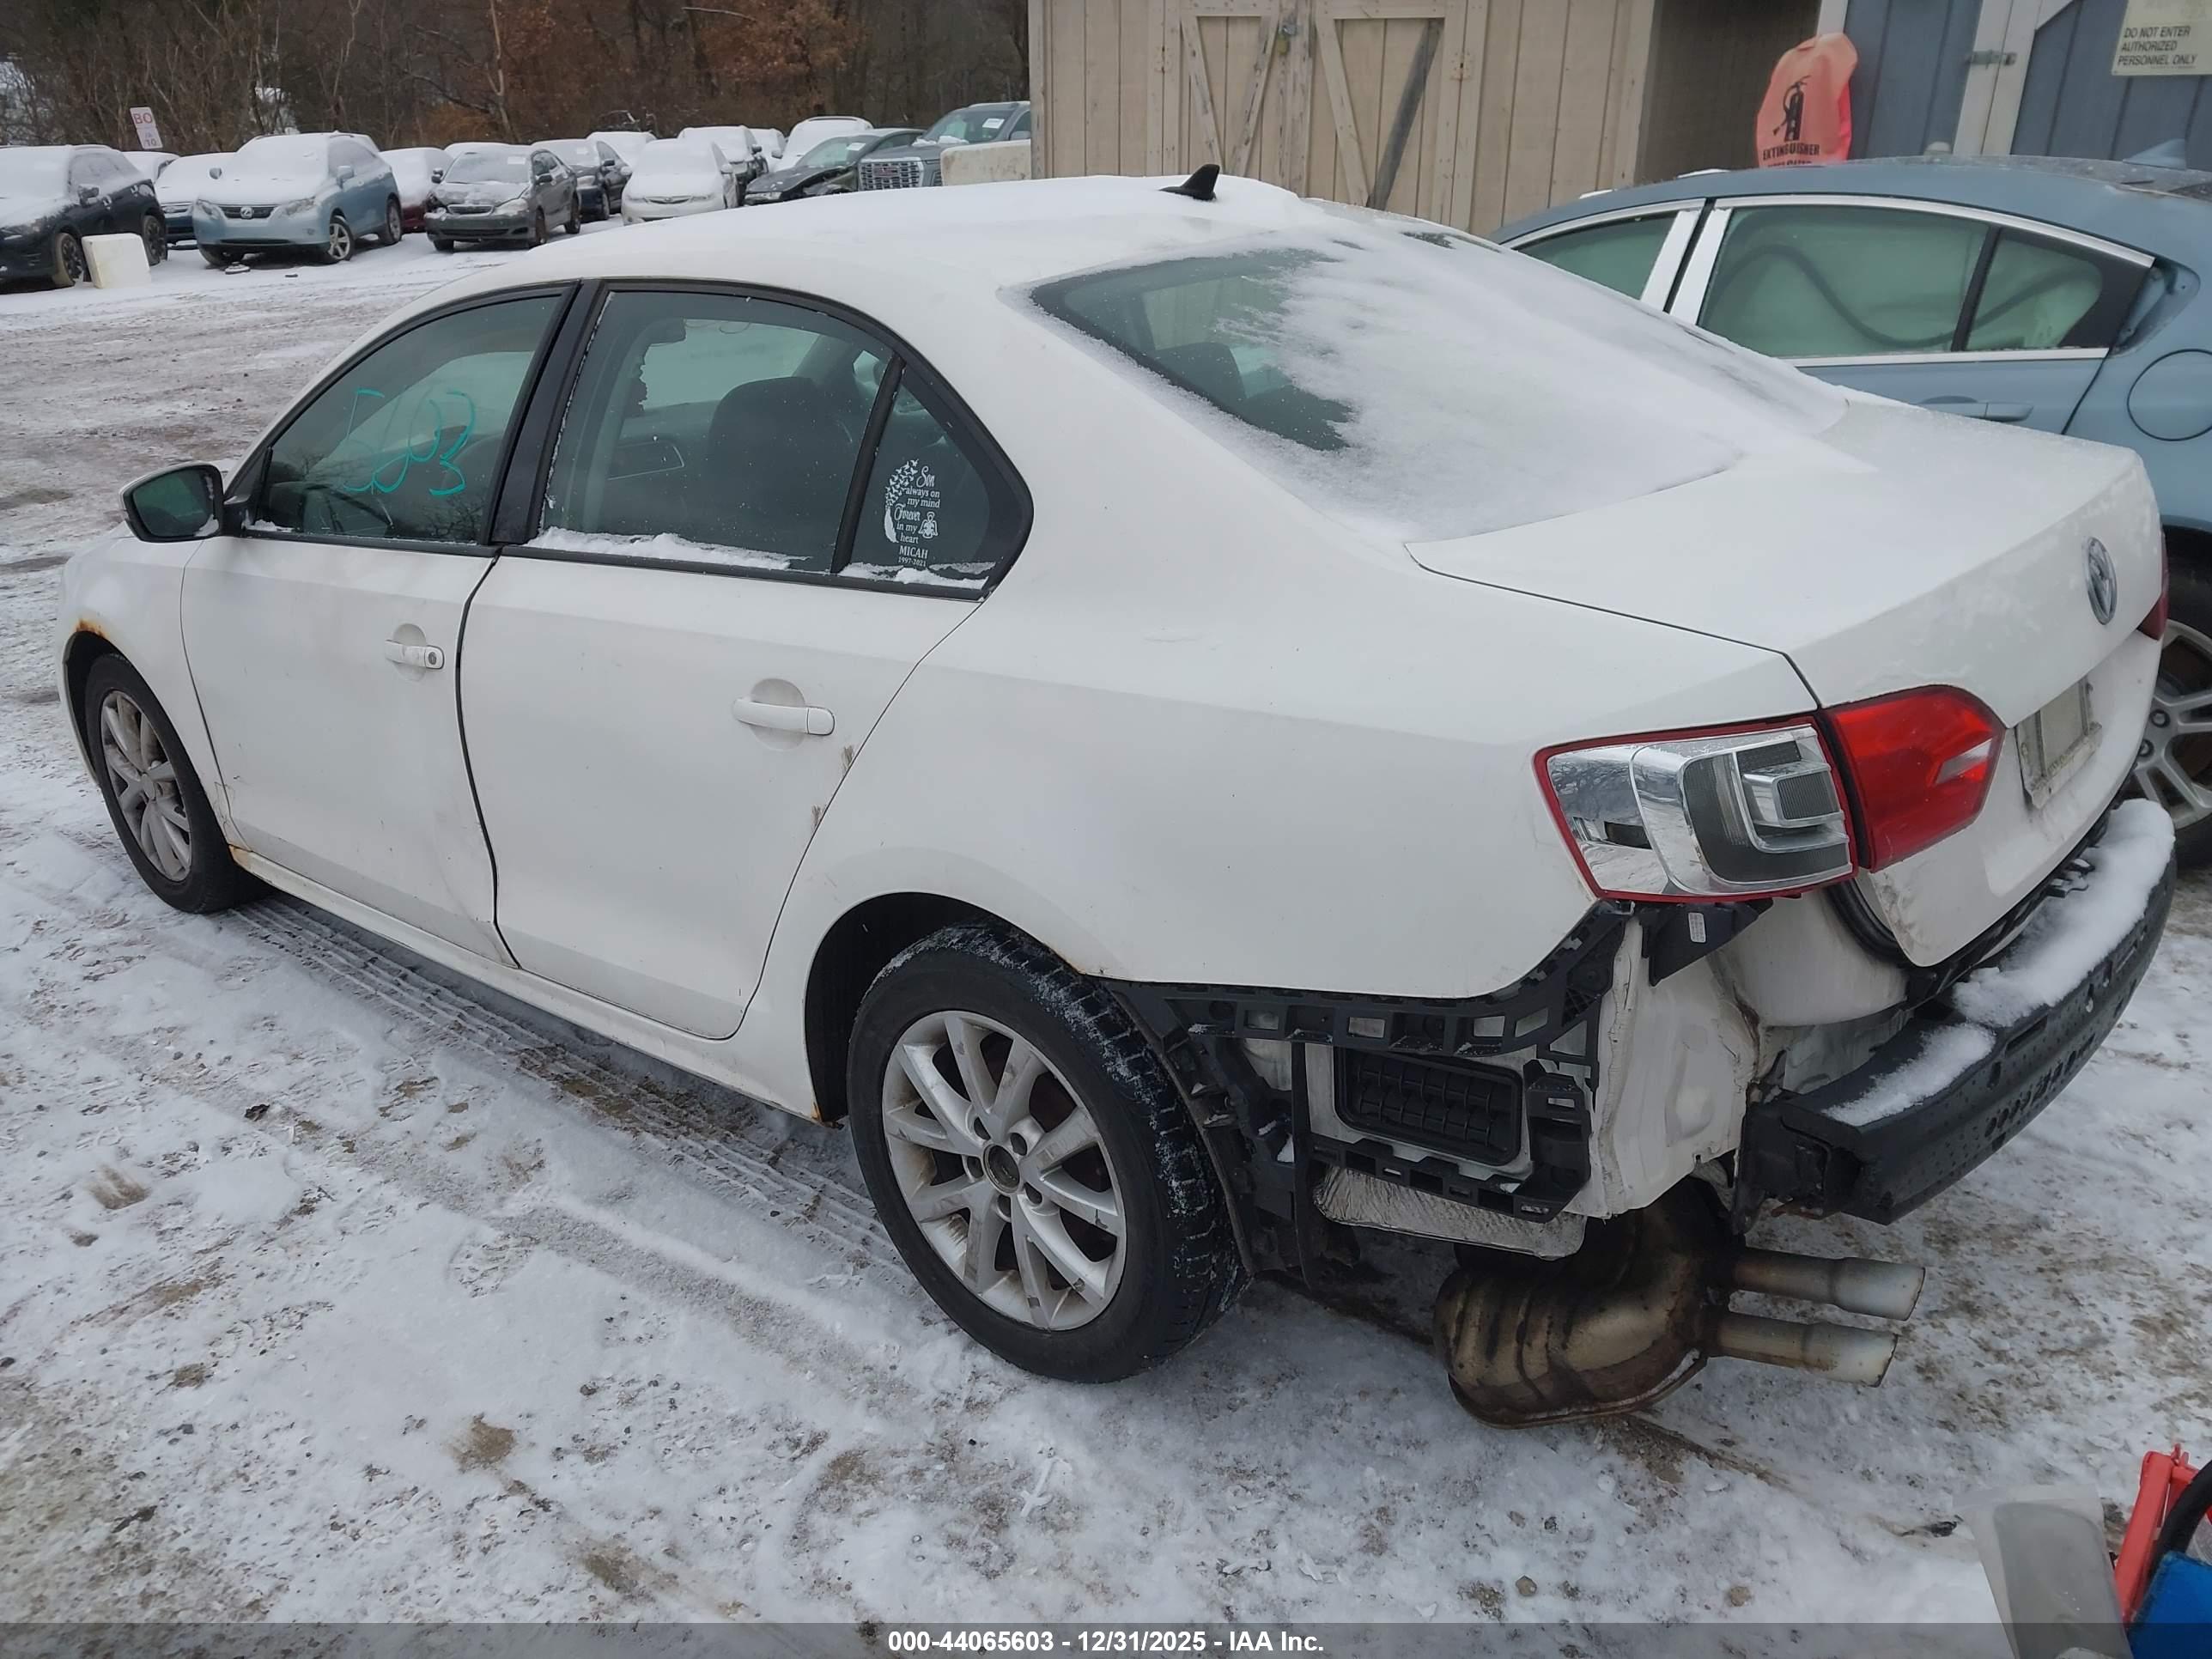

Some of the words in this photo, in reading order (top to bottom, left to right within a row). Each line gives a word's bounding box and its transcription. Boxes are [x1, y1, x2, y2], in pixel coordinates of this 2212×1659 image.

[2124, 27, 2138, 38] DO
[2139, 27, 2159, 38] NOT
[2160, 26, 2191, 37] ENTER
[2121, 40, 2178, 52] AUTHORIZED
[2118, 54, 2170, 66] PERSONNEL
[2172, 53, 2198, 65] ONLY
[1762, 143, 1820, 161] EXTINGUISHER
[915, 465, 935, 488] Son
[905, 487, 929, 498] always
[907, 497, 920, 508] my
[921, 499, 940, 508] mind
[894, 503, 921, 521] Forever
[896, 520, 904, 530] in
[905, 525, 918, 533] my
[900, 532, 919, 544] heart
[898, 545, 928, 559] MICAH
